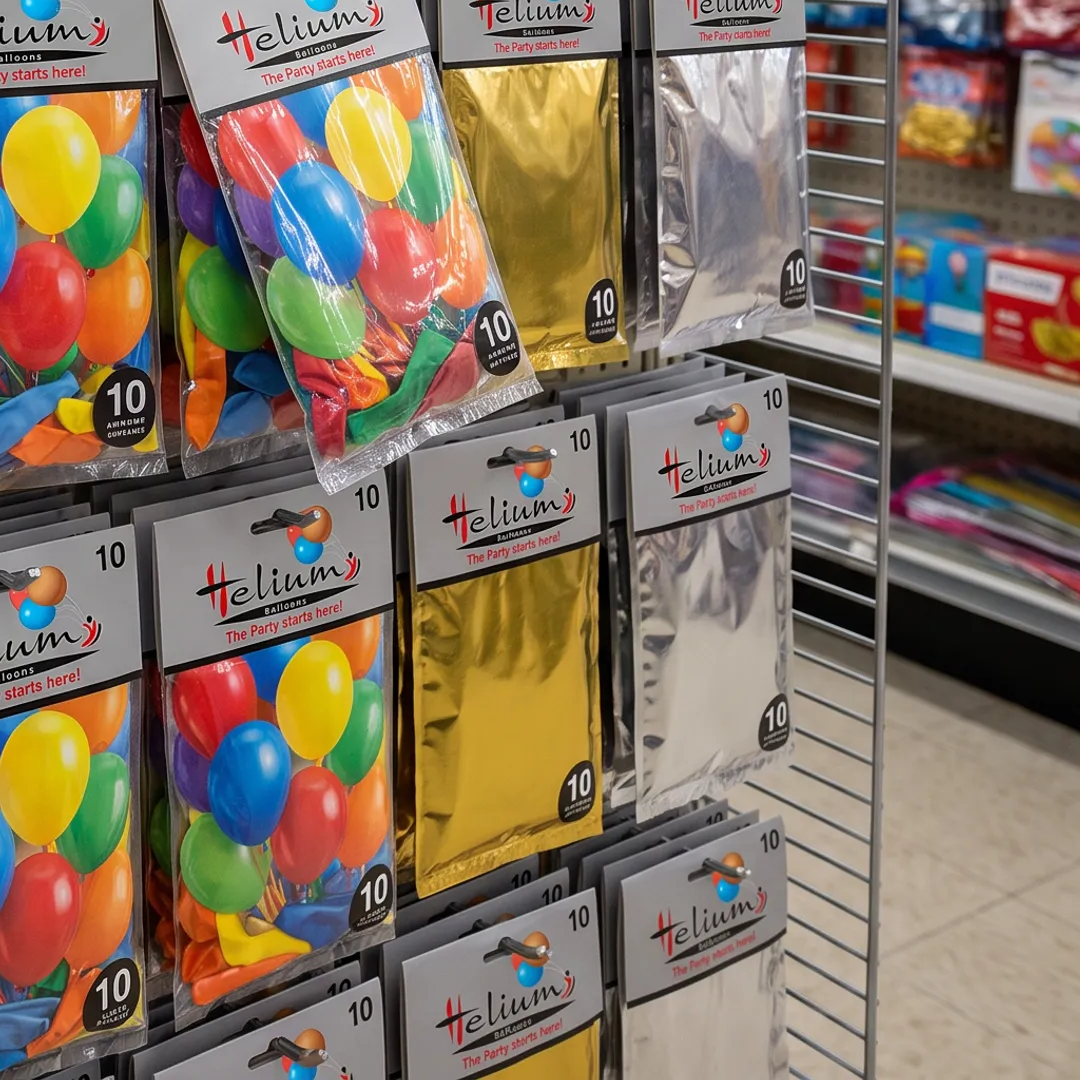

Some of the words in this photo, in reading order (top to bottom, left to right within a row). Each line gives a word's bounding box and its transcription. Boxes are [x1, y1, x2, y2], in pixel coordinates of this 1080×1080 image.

[216, 10, 369, 63] Helium
[493, 43, 510, 53] The
[511, 42, 534, 54] Party
[535, 40, 558, 51] starts
[559, 38, 580, 48] here!
[699, 31, 713, 42] The
[714, 30, 733, 42] Party
[11, 67, 49, 81] starts
[51, 65, 86, 78] here!
[261, 72, 284, 87] The
[285, 63, 315, 81] Party
[317, 54, 347, 71] starts
[348, 44, 376, 62] here!
[786, 257, 805, 286] 10
[592, 287, 614, 318] 10
[480, 310, 511, 348] 10
[106, 379, 146, 417] 10
[763, 387, 783, 410] 10
[569, 428, 590, 452] 10
[658, 446, 759, 494] Helium
[354, 484, 380, 511] 10
[441, 493, 562, 544] Helium
[96, 541, 126, 572] 10
[466, 553, 485, 565] The
[487, 546, 511, 561] Party
[512, 539, 536, 554] starts
[538, 530, 560, 547] here!
[195, 561, 346, 618] Helium
[225, 631, 247, 644] The
[250, 621, 280, 637] Party
[282, 612, 313, 629] starts
[316, 600, 343, 619] here!
[5, 680, 42, 701] starts
[46, 667, 81, 690] here!
[765, 701, 787, 732] 10
[567, 768, 592, 802] 10
[760, 829, 780, 853] 10
[360, 873, 388, 912] 10
[569, 905, 590, 932] 10
[649, 900, 755, 957] Helium
[95, 968, 131, 1011] 10
[348, 996, 373, 1027] 10
[435, 984, 562, 1046] Helium
[462, 1056, 481, 1070] The
[484, 1044, 509, 1061] Party
